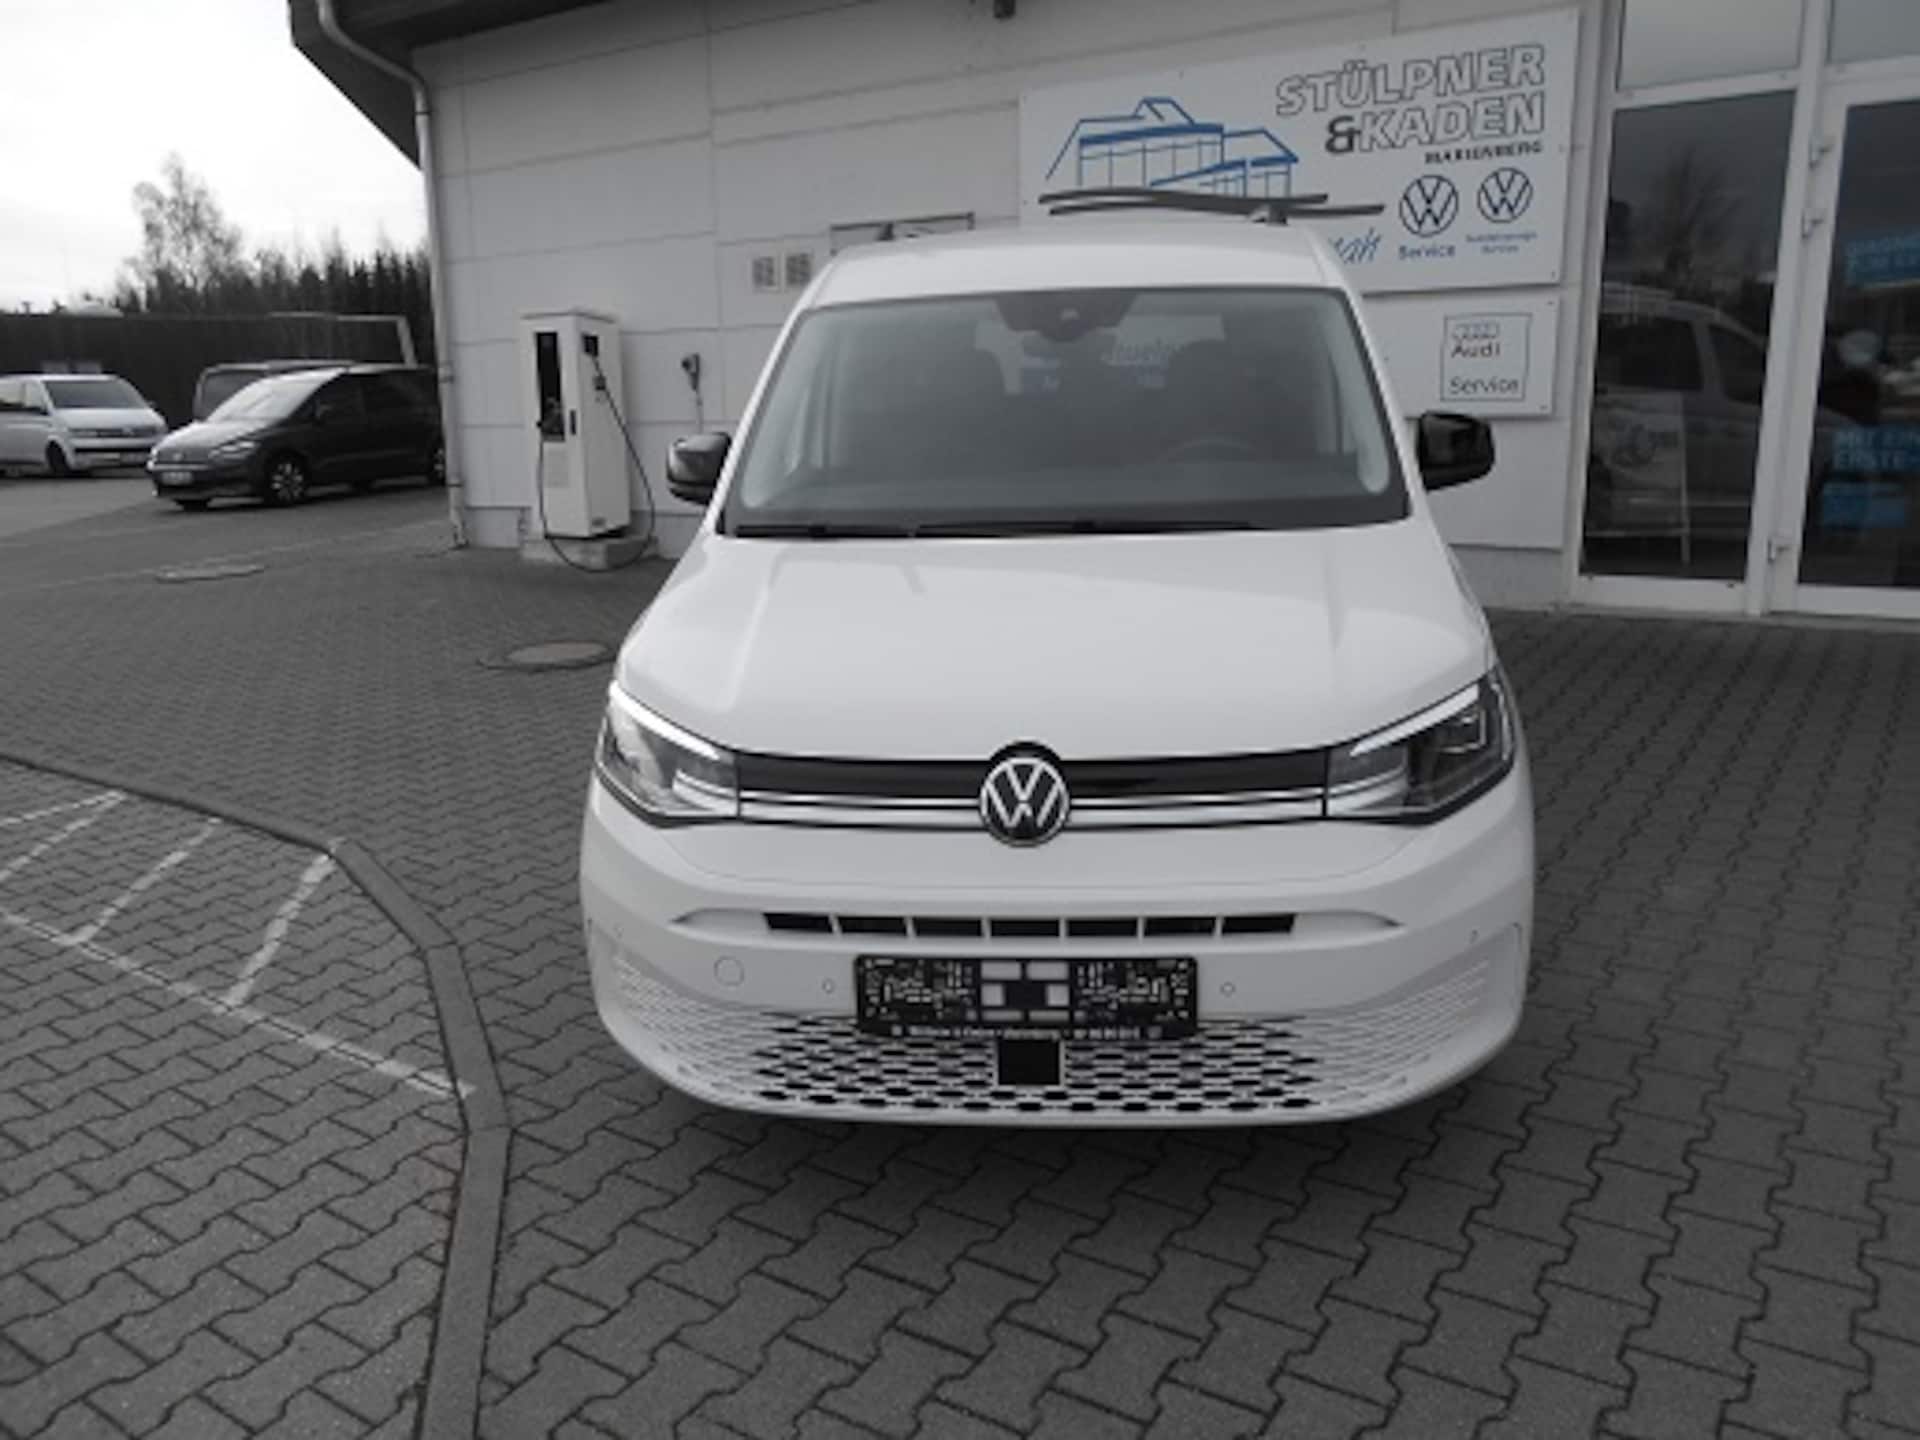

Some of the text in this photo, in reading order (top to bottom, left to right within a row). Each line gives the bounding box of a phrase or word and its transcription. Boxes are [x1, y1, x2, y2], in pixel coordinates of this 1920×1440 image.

[1275, 44, 1545, 116] STÜLPNER
[1324, 91, 1545, 154] &KADEN
[1399, 242, 1456, 260] Service
[1450, 341, 1501, 358] Audi
[1448, 376, 1519, 395] Service
